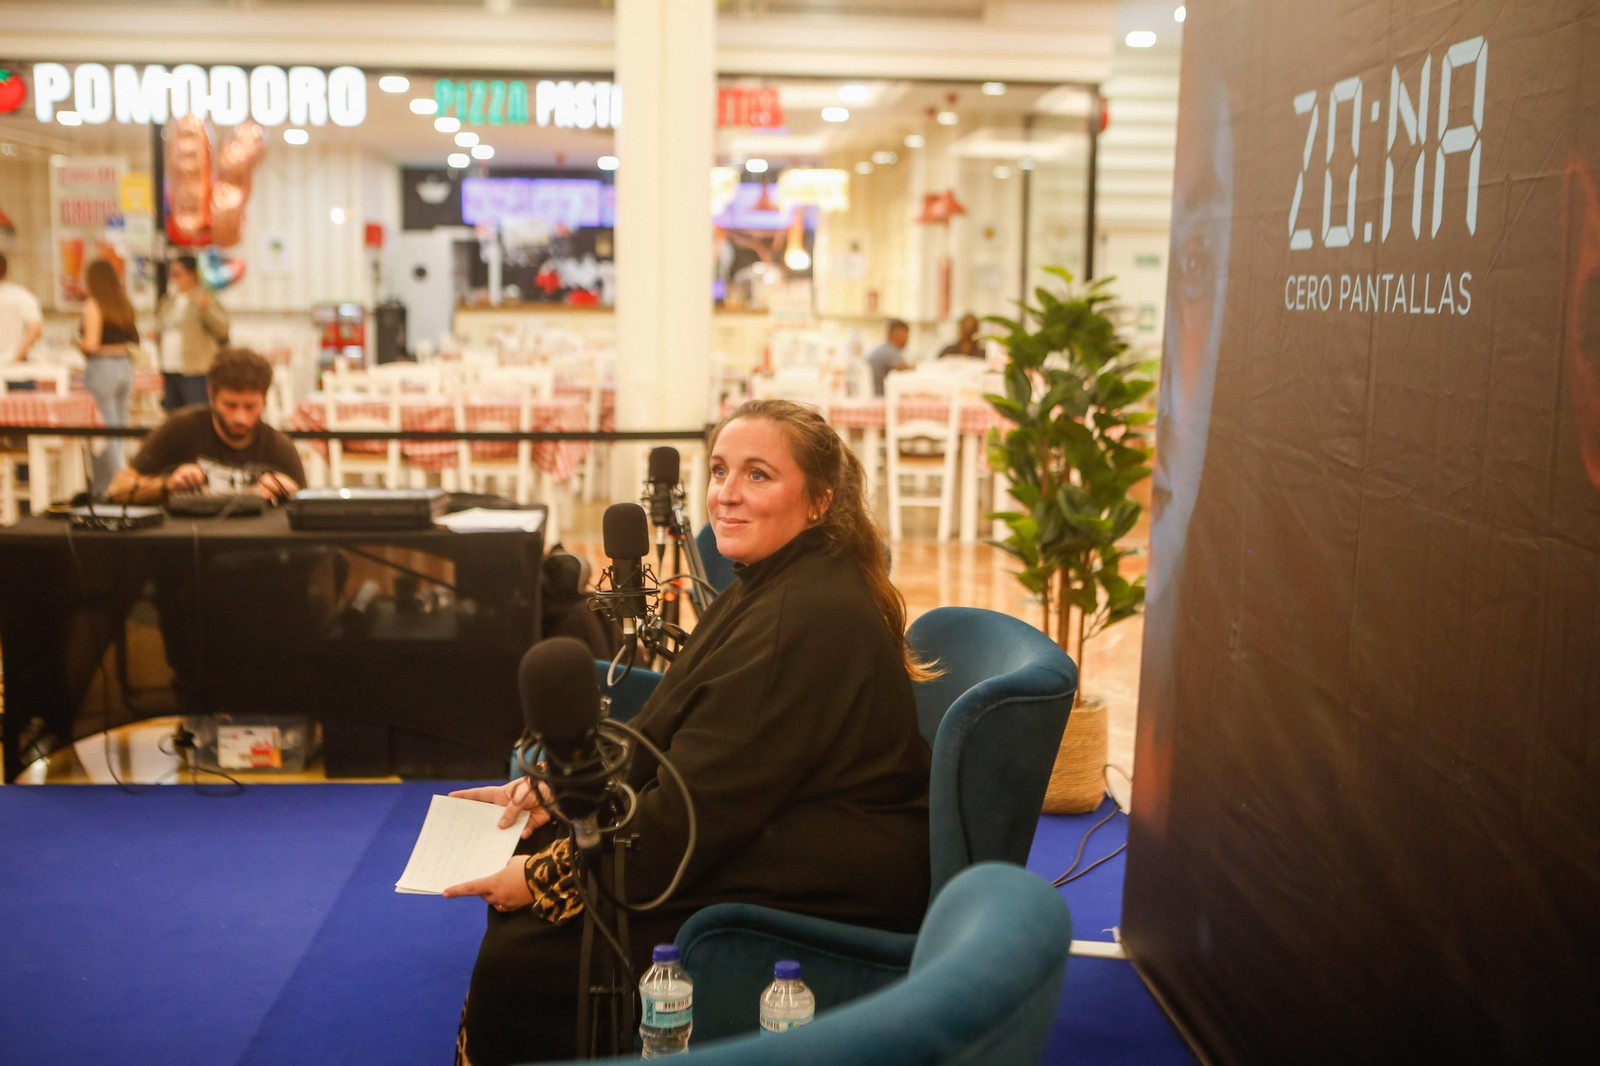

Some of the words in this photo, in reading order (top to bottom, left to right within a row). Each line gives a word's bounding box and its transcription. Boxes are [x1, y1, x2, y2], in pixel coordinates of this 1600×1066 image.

[33, 62, 367, 127] POMODORO
[434, 79, 529, 126] PIZZA
[1284, 273, 1333, 312] CERO
[1338, 271, 1473, 316] PANTALLAS
